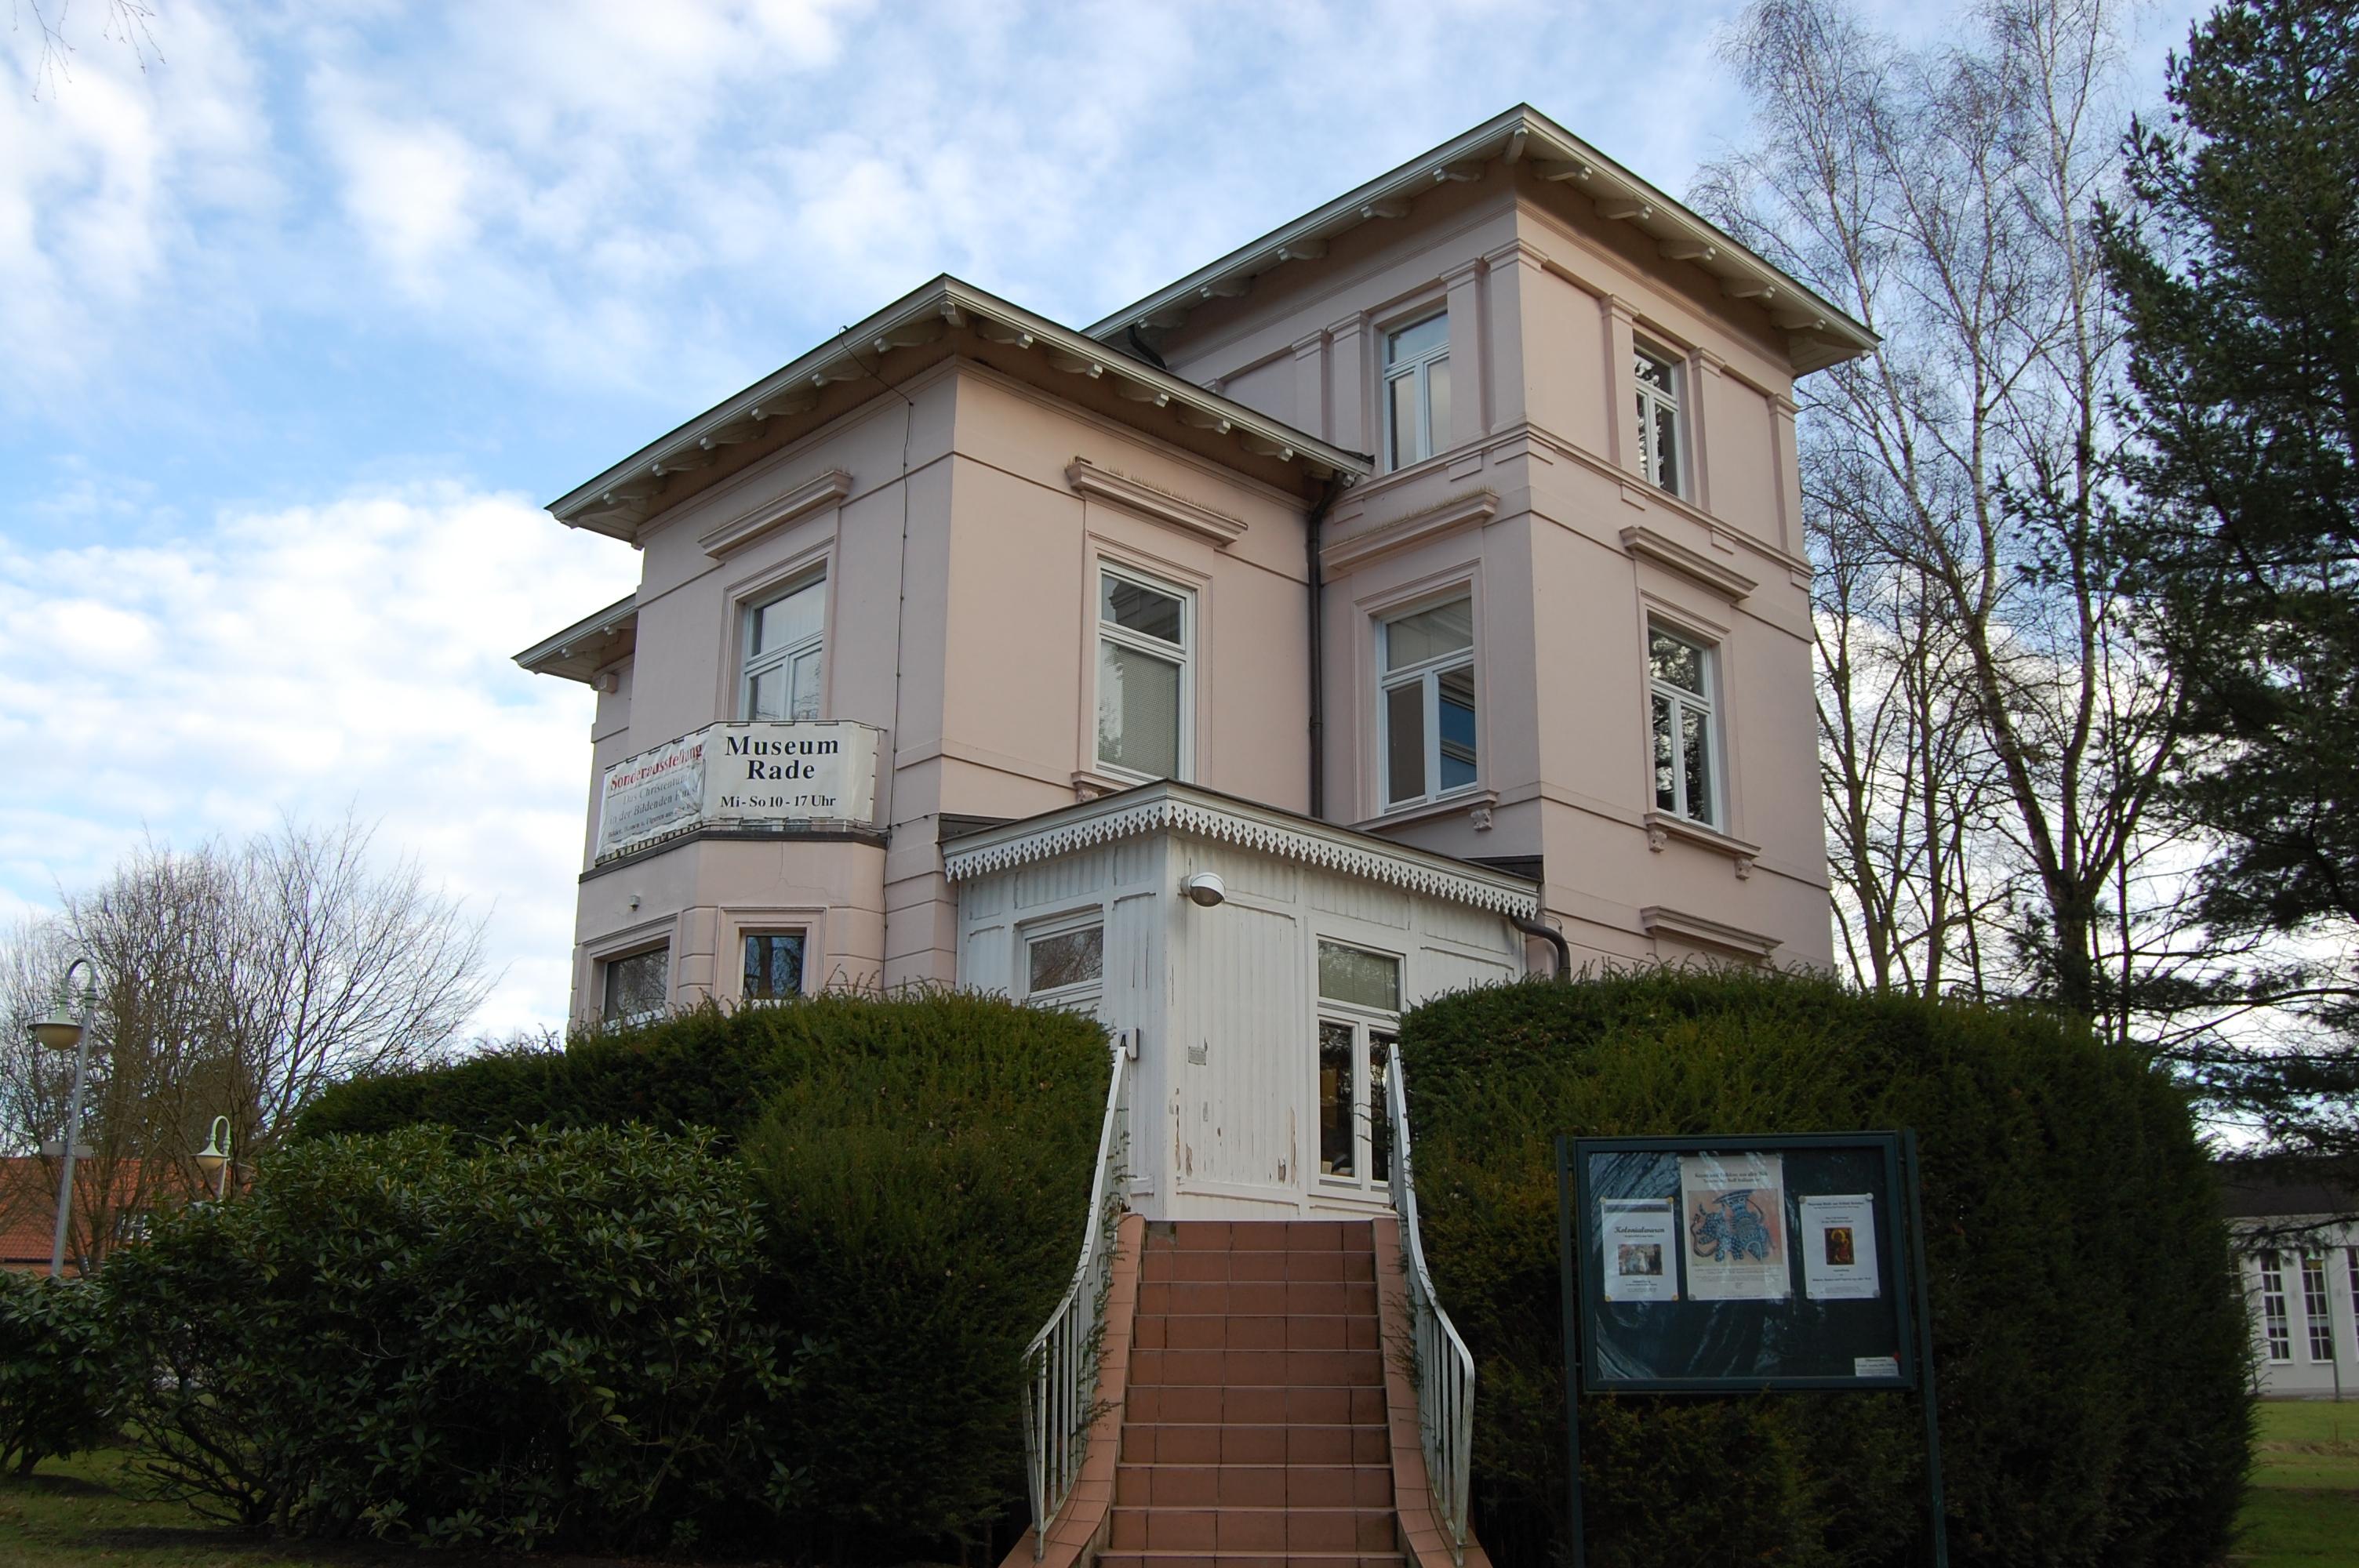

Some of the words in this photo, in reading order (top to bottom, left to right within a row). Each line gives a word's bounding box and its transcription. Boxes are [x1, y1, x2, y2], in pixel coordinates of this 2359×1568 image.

[725, 735, 838, 756] Museum
[610, 744, 703, 791] Sonderausstellung
[747, 759, 815, 780] Rade
[620, 810, 632, 822] der
[634, 795, 672, 815] Bildenden
[623, 794, 637, 804] Das
[749, 795, 766, 808] So
[769, 796, 783, 808] 10
[794, 795, 809, 807] 17
[811, 794, 836, 807] Uhr
